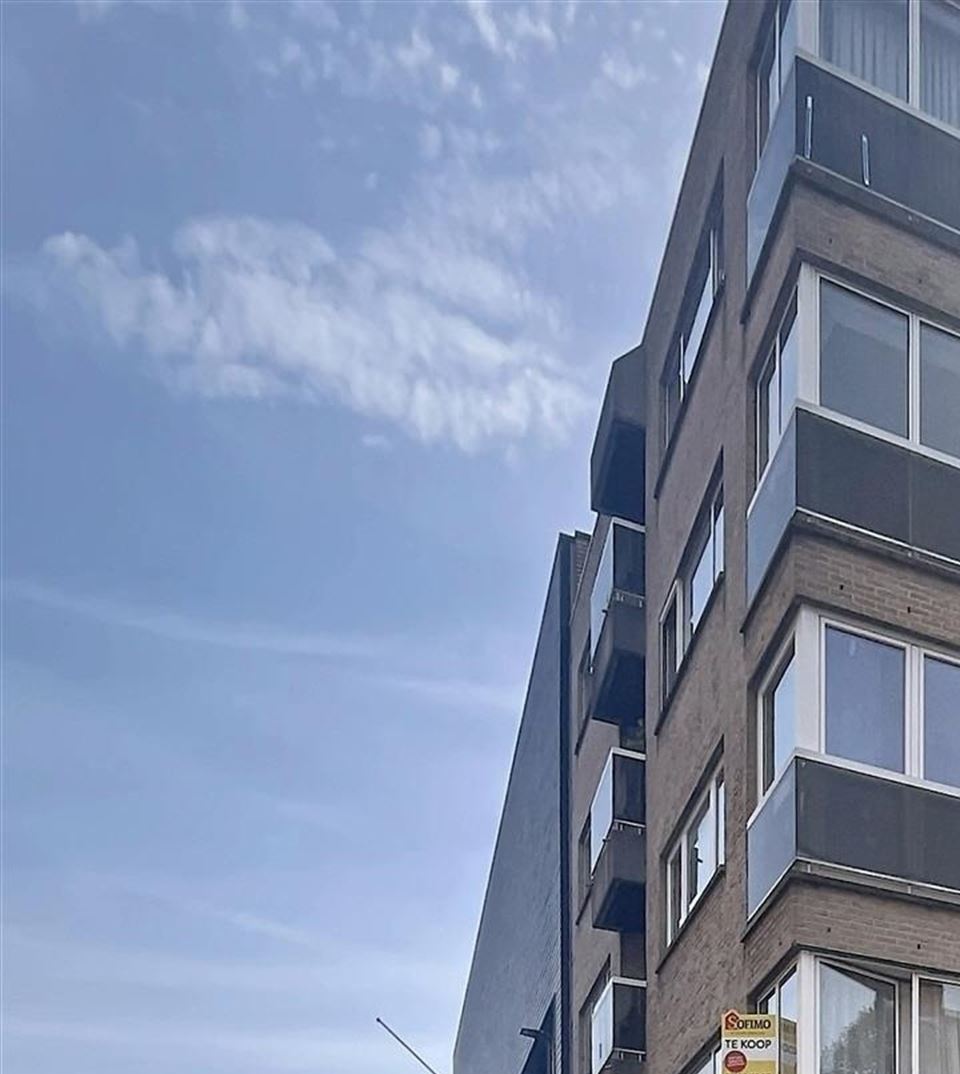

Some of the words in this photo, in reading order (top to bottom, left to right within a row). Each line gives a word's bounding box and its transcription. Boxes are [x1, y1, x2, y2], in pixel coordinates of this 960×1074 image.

[725, 1012, 771, 1030] SOFIMO
[725, 1040, 738, 1048] TE
[741, 1040, 771, 1049] KOOP
